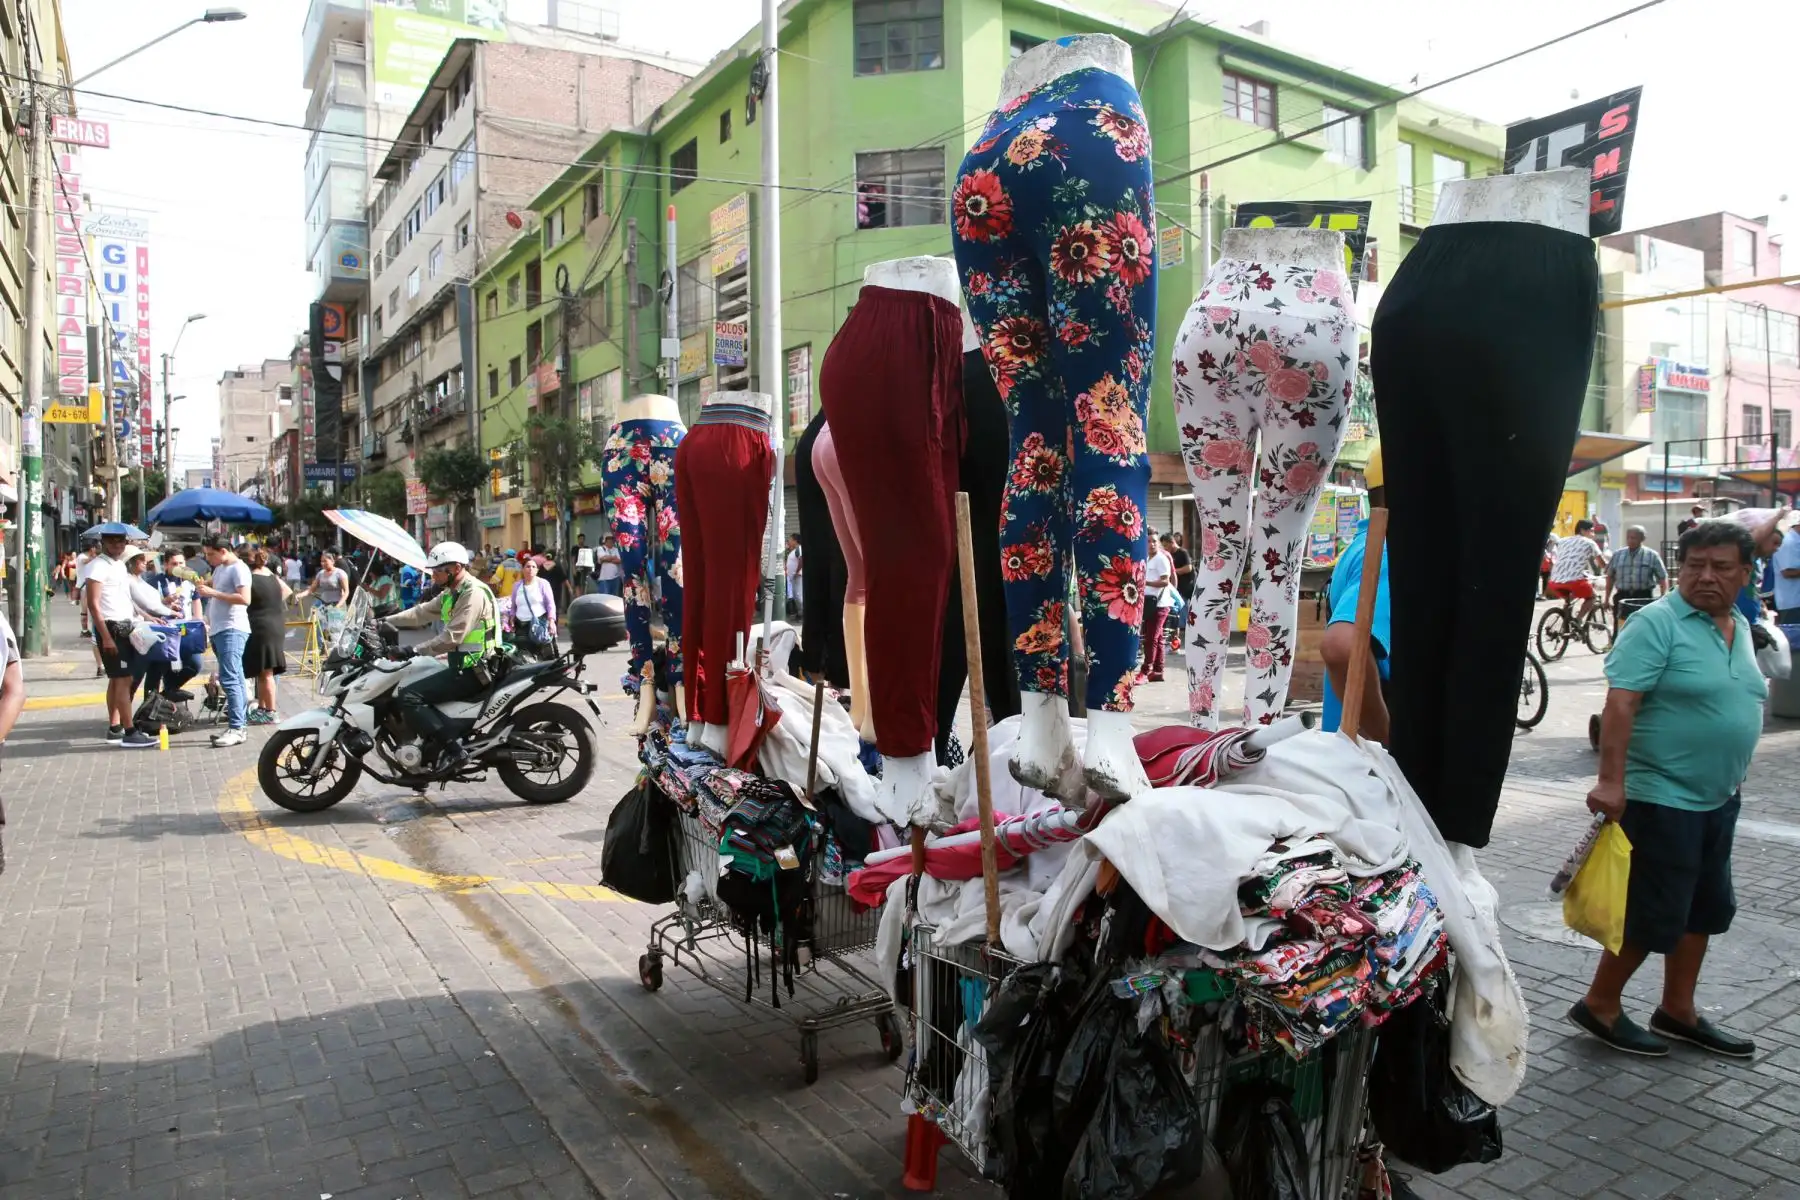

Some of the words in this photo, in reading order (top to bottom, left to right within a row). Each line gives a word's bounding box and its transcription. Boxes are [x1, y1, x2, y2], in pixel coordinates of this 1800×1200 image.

[52, 120, 105, 143] ERIAS
[54, 154, 86, 395] INDUSTRIALES
[715, 322, 743, 336] POLOS
[715, 338, 743, 350] GORROS
[138, 253, 152, 463] INDUSTRIALES
[304, 467, 338, 477] GAMARR
[484, 692, 513, 719] POLICIA
